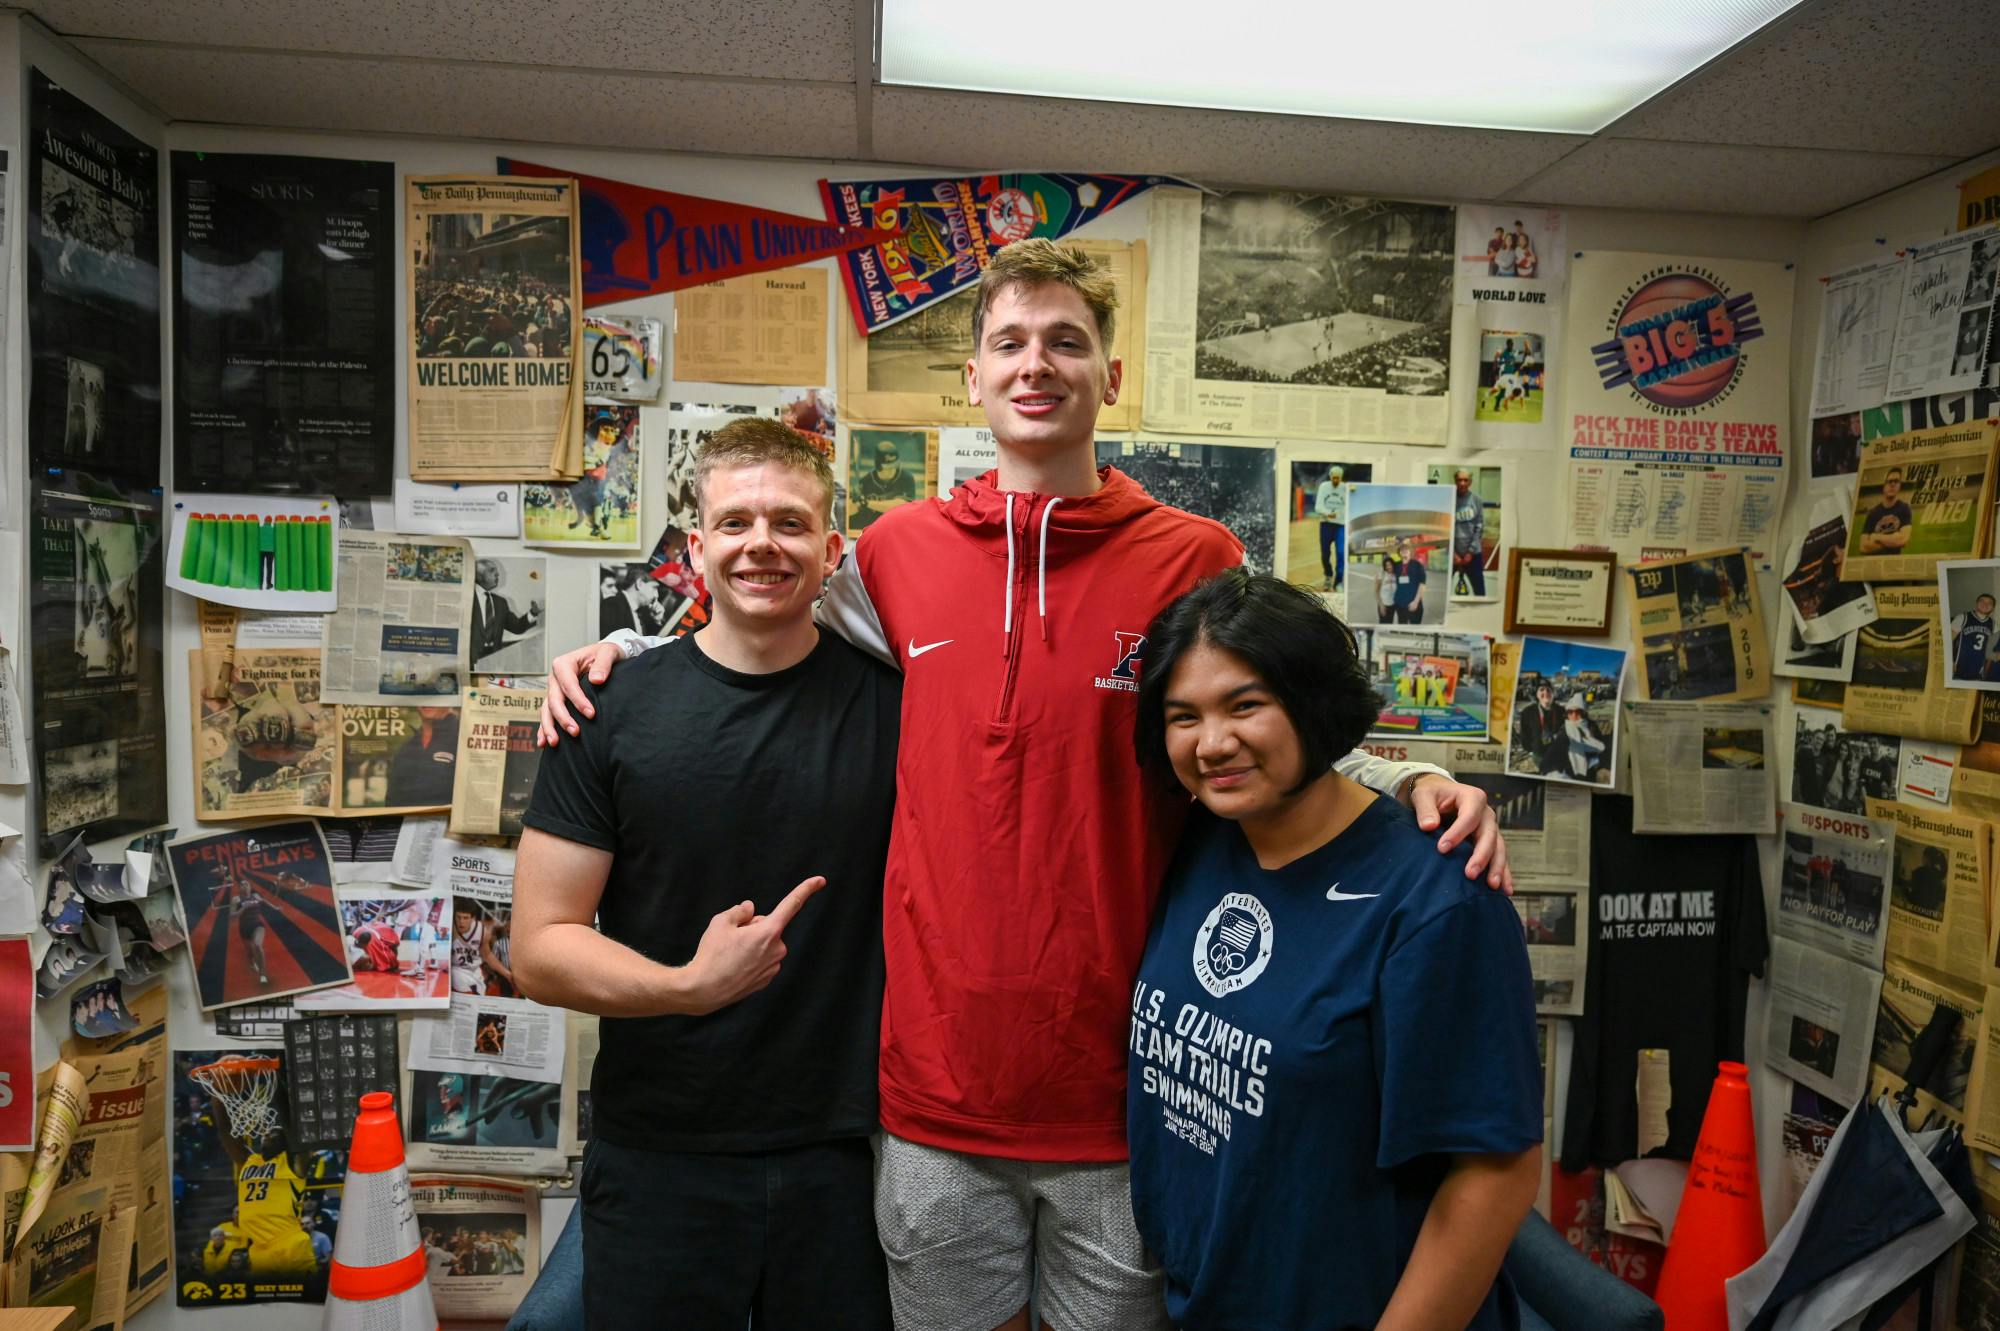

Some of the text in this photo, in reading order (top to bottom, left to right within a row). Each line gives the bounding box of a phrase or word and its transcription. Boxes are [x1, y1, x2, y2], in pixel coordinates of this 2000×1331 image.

[42, 127, 109, 186] Awesome
[421, 187, 561, 203] The Daily Pennsylvanian
[931, 181, 977, 281] WORLD
[959, 181, 991, 269] CHAMPIONS
[340, 240, 366, 249] dinner
[645, 204, 743, 281] PENN
[766, 279, 806, 290] Harvard
[859, 248, 889, 323] NEW YORK
[1472, 289, 1547, 304] WORLD LOVE
[1606, 287, 1635, 332] TEMPLE
[1641, 265, 1674, 282] PENN
[1621, 302, 1735, 376] BIG 5
[416, 361, 571, 387] WELCOME HOME!
[583, 381, 617, 392] STATE
[1646, 402, 1698, 417] JOSEPH'S
[1708, 353, 1749, 408] VILLANOVA
[940, 395, 964, 408] The
[1573, 415, 1777, 439] PICK THE DAILY NEWS
[1573, 431, 1784, 455] ALL-TIME BIG 5 TEAM.
[1890, 439, 1910, 452] Daily
[1911, 429, 1982, 450] Pennsylvanian
[955, 449, 971, 457] ALL
[1574, 449, 1606, 458] CONTEST
[1608, 449, 1628, 459] RUNS
[1629, 450, 1663, 461] JANUARY
[1689, 453, 1708, 463] ONLY
[1710, 455, 1719, 463] IN
[1721, 455, 1734, 464] THE
[1735, 456, 1756, 465] DAILY
[1758, 457, 1779, 467] NEWS
[1906, 463, 1940, 481] WHEN
[1931, 475, 1969, 489] PLAYER
[1910, 491, 1936, 505] GETS
[1878, 593, 1899, 607] Daily
[1973, 634, 1985, 650] 3
[1740, 628, 1754, 680] 2019
[241, 669, 306, 680] Fighting for
[479, 694, 531, 710] The Daily
[341, 706, 399, 719] WAIT IS
[341, 719, 405, 736] OVER
[472, 723, 489, 737] AN
[1455, 749, 1505, 764] The Daily
[1875, 805, 1895, 820] The
[184, 840, 248, 865] PENN
[235, 843, 318, 870] RELAYS
[452, 856, 490, 872] SPORTS
[456, 884, 475, 893] know
[476, 889, 492, 897] your
[1649, 891, 1679, 921] AT
[1679, 889, 1716, 919] ME
[1784, 896, 1802, 911] NO
[1825, 907, 1846, 925] FOR
[1250, 899, 1271, 934] STATES
[1616, 920, 1716, 939] THE CAPTAIN NOW
[1197, 959, 1243, 993] OLYMPIC TEAM
[1132, 980, 1273, 1077] U.S. OLYMPIC
[1129, 1014, 1265, 1118] TEAM TRIALS
[100, 1097, 145, 1119] issue
[1142, 1065, 1232, 1142] SWIMMING
[240, 1162, 277, 1182] IOWA
[244, 1181, 269, 1202] 23
[78, 1210, 94, 1228] AT
[218, 1283, 247, 1300] 23
